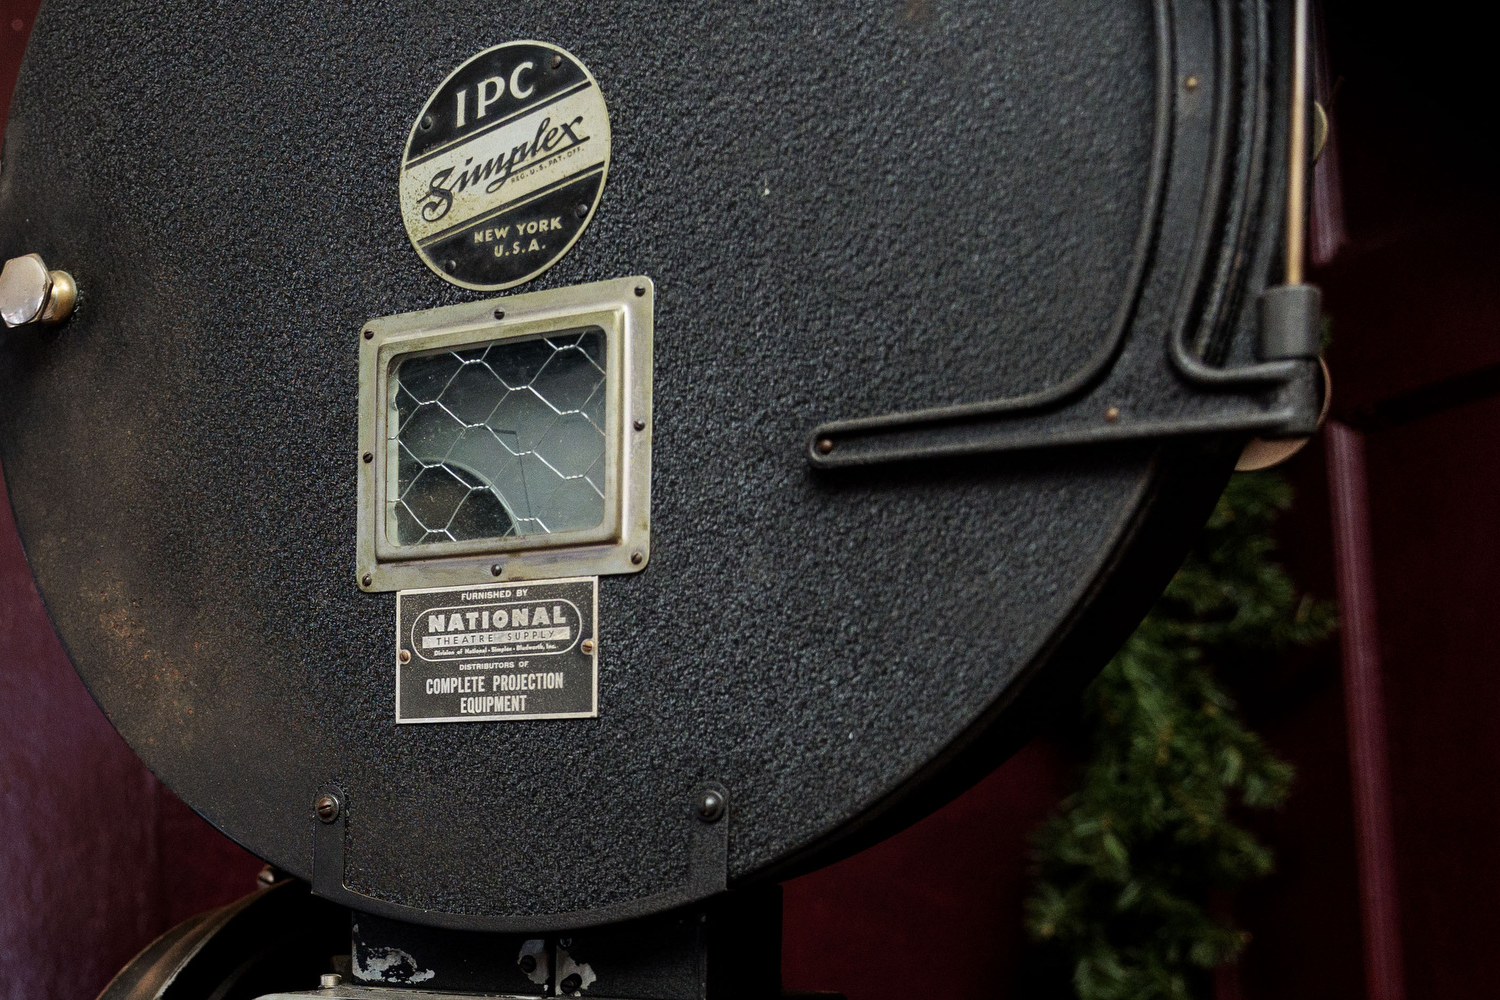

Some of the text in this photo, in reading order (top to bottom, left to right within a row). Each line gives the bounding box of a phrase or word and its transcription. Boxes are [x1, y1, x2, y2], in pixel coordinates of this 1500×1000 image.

[455, 62, 534, 128] IPC
[417, 115, 591, 222] Simplex
[474, 216, 563, 244] NEW YORK
[494, 240, 547, 258] U.S.A.
[461, 588, 528, 601] FURNISHED BY
[428, 605, 566, 633] NATIONAL
[436, 630, 555, 646] THEATRE SUPPLY
[459, 660, 529, 671] DISTRIBUTORS OF
[425, 672, 563, 695] COMPLETE PROJECTION
[460, 695, 527, 714] EQUIPMENT
